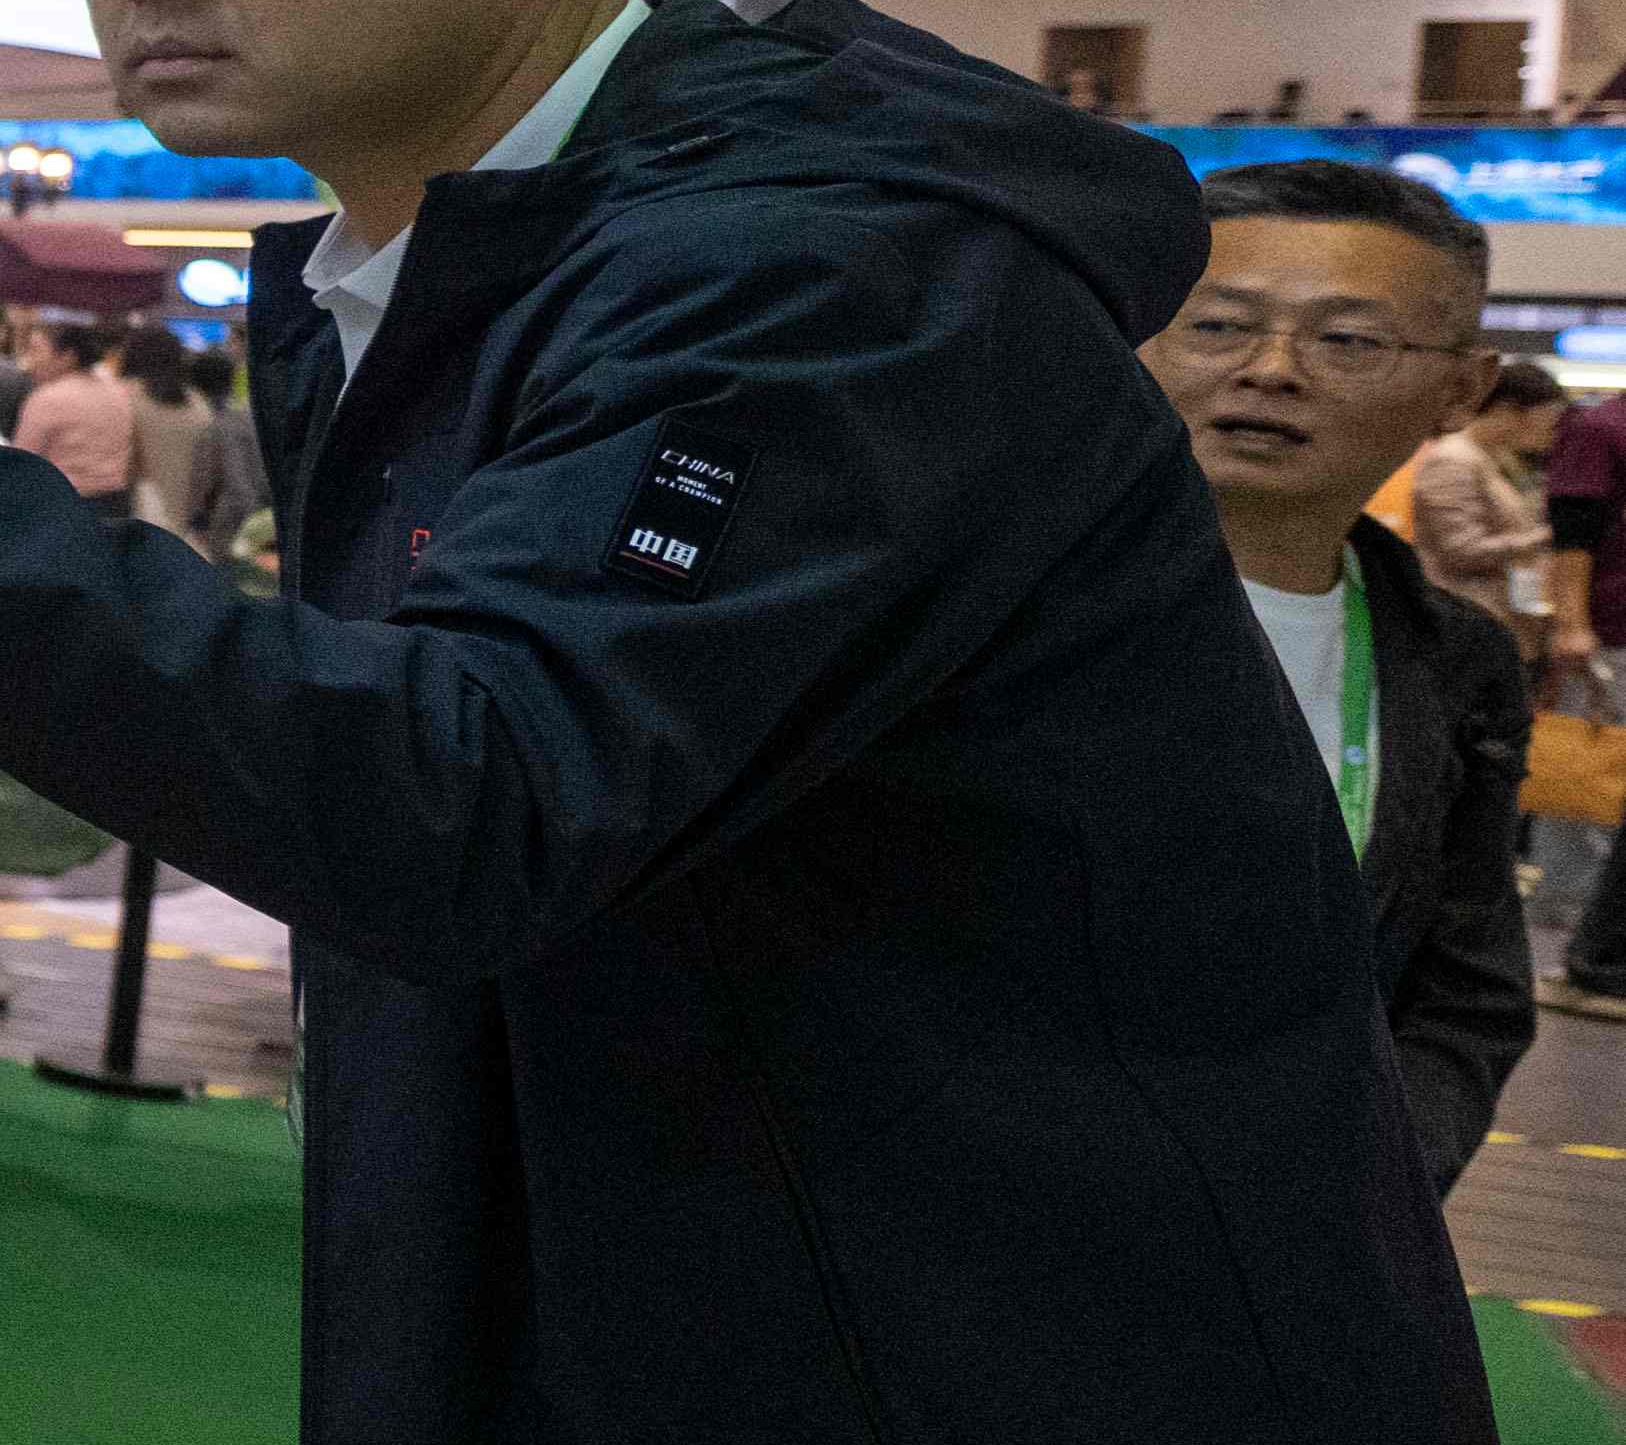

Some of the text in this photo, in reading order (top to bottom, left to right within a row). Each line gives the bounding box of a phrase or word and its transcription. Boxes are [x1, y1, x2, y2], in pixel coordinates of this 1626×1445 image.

[660, 449, 737, 485] CHINA
[676, 475, 708, 491] MOMENT
[655, 475, 723, 506] OF A CHAMPION
[628, 527, 699, 570] 中国
